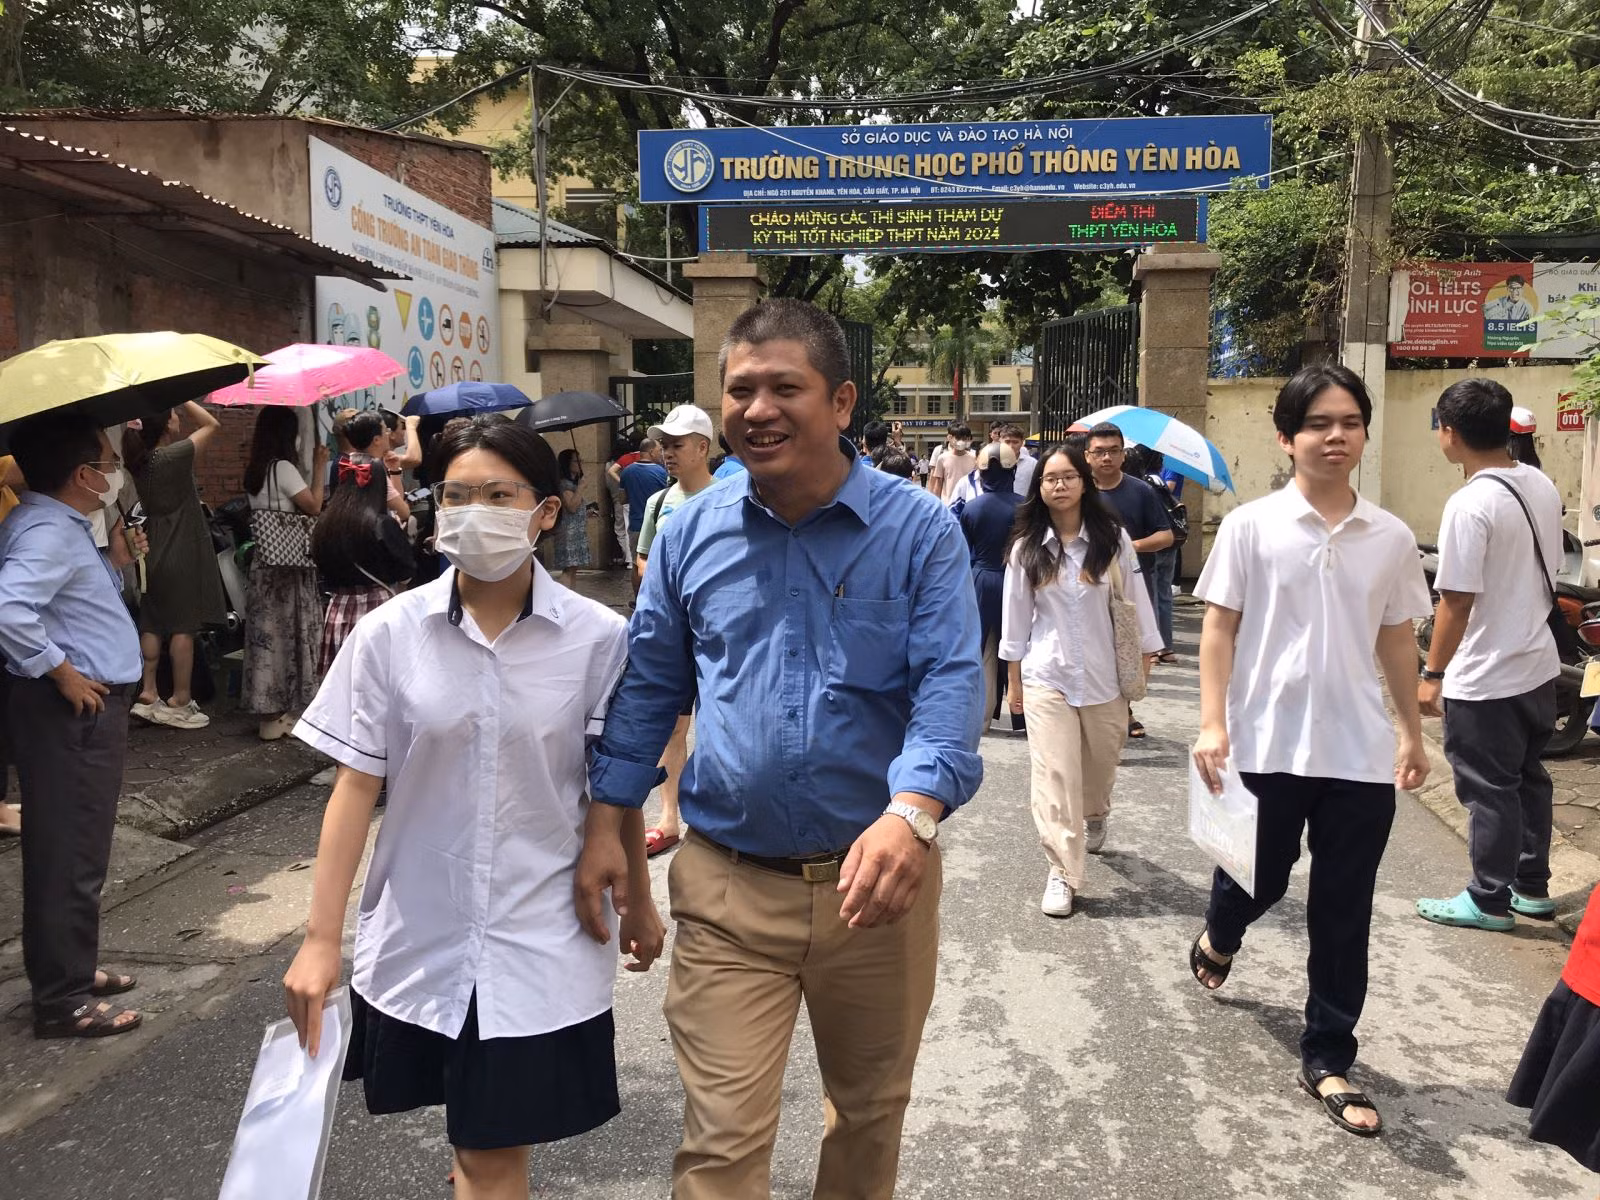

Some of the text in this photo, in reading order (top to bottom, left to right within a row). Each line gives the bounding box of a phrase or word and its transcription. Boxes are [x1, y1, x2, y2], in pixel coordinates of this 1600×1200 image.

[841, 124, 1073, 147] SỞ GIÁO DỤC VÀ ĐÀO TẠO HÀ NỘI
[720, 140, 1241, 182] TRƯỜNG TRUNG HỌC PHỔ THÔNG YÊN HÒA
[780, 189, 791, 197] 251
[897, 209, 932, 224] SINH
[935, 208, 977, 223] THAM
[1130, 204, 1155, 219] THI
[773, 230, 797, 244] THI
[886, 228, 925, 243] THPT
[964, 226, 1000, 241] 2024
[1068, 223, 1108, 238] THPT
[1110, 220, 1139, 238] YÊN
[1410, 280, 1481, 296] OL IELTS
[1578, 282, 1598, 292] Khi
[1409, 297, 1478, 317] ÌNH LỰC
[1487, 322, 1505, 332] 8.5
[1562, 412, 1579, 425] ÔTÔ
